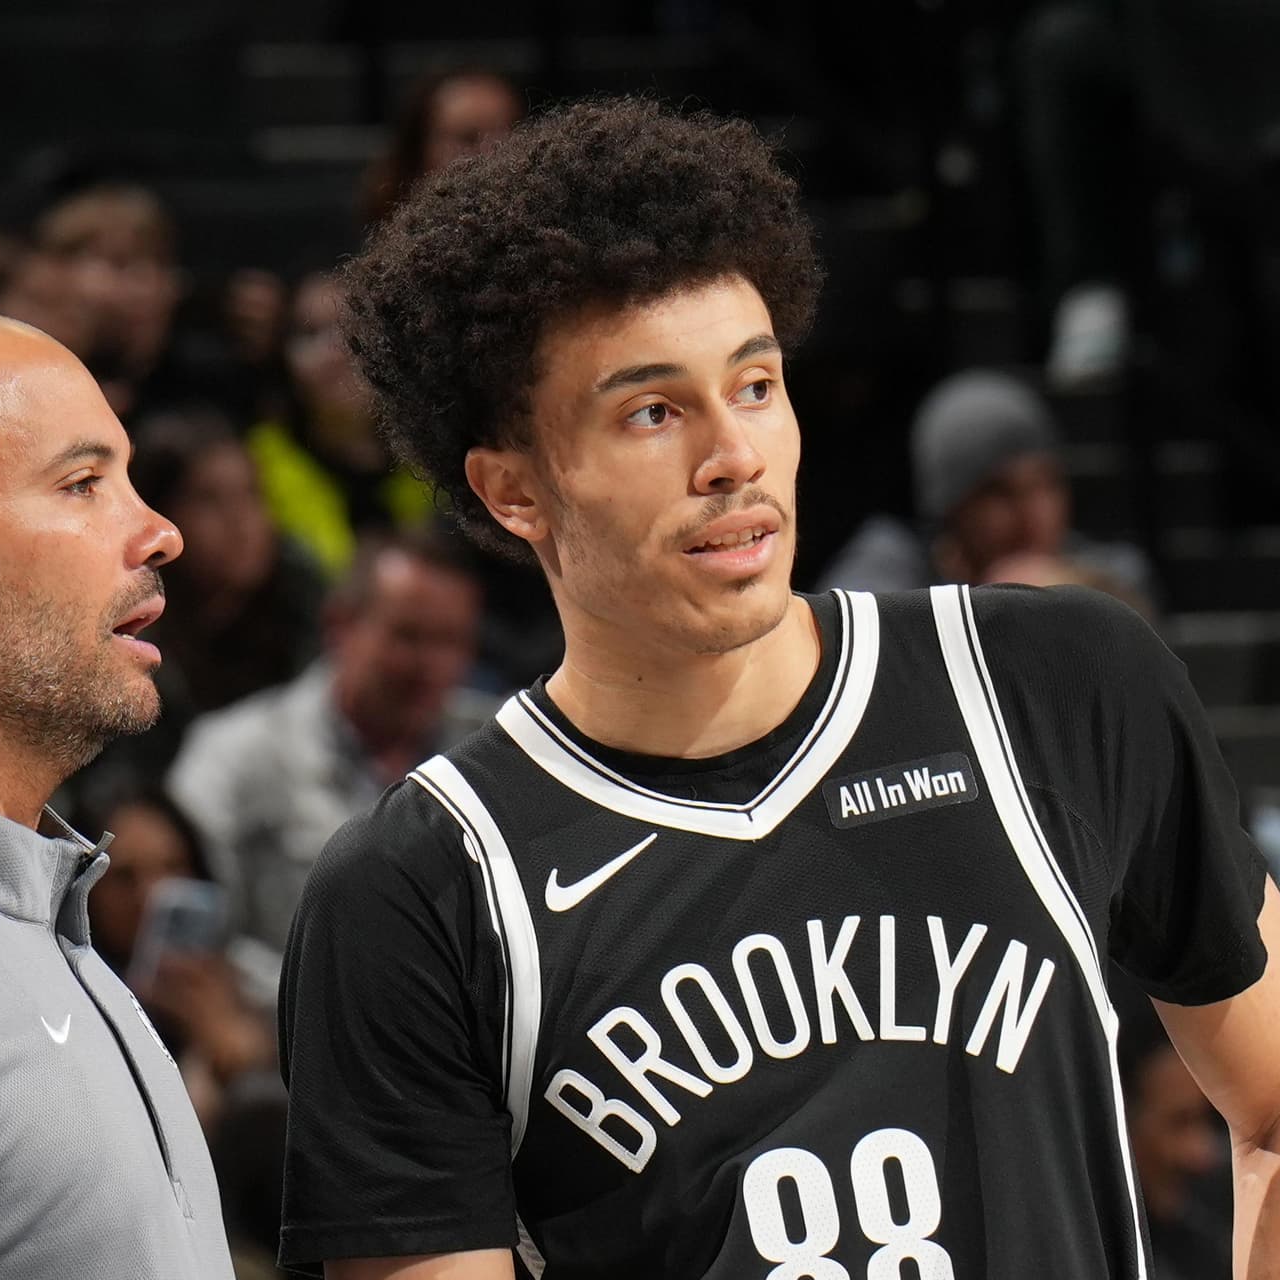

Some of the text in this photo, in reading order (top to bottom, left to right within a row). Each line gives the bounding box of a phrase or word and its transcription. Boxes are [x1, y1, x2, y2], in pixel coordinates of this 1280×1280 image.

[839, 766, 967, 819] All In Won
[543, 914, 1055, 1174] BROOKLYN
